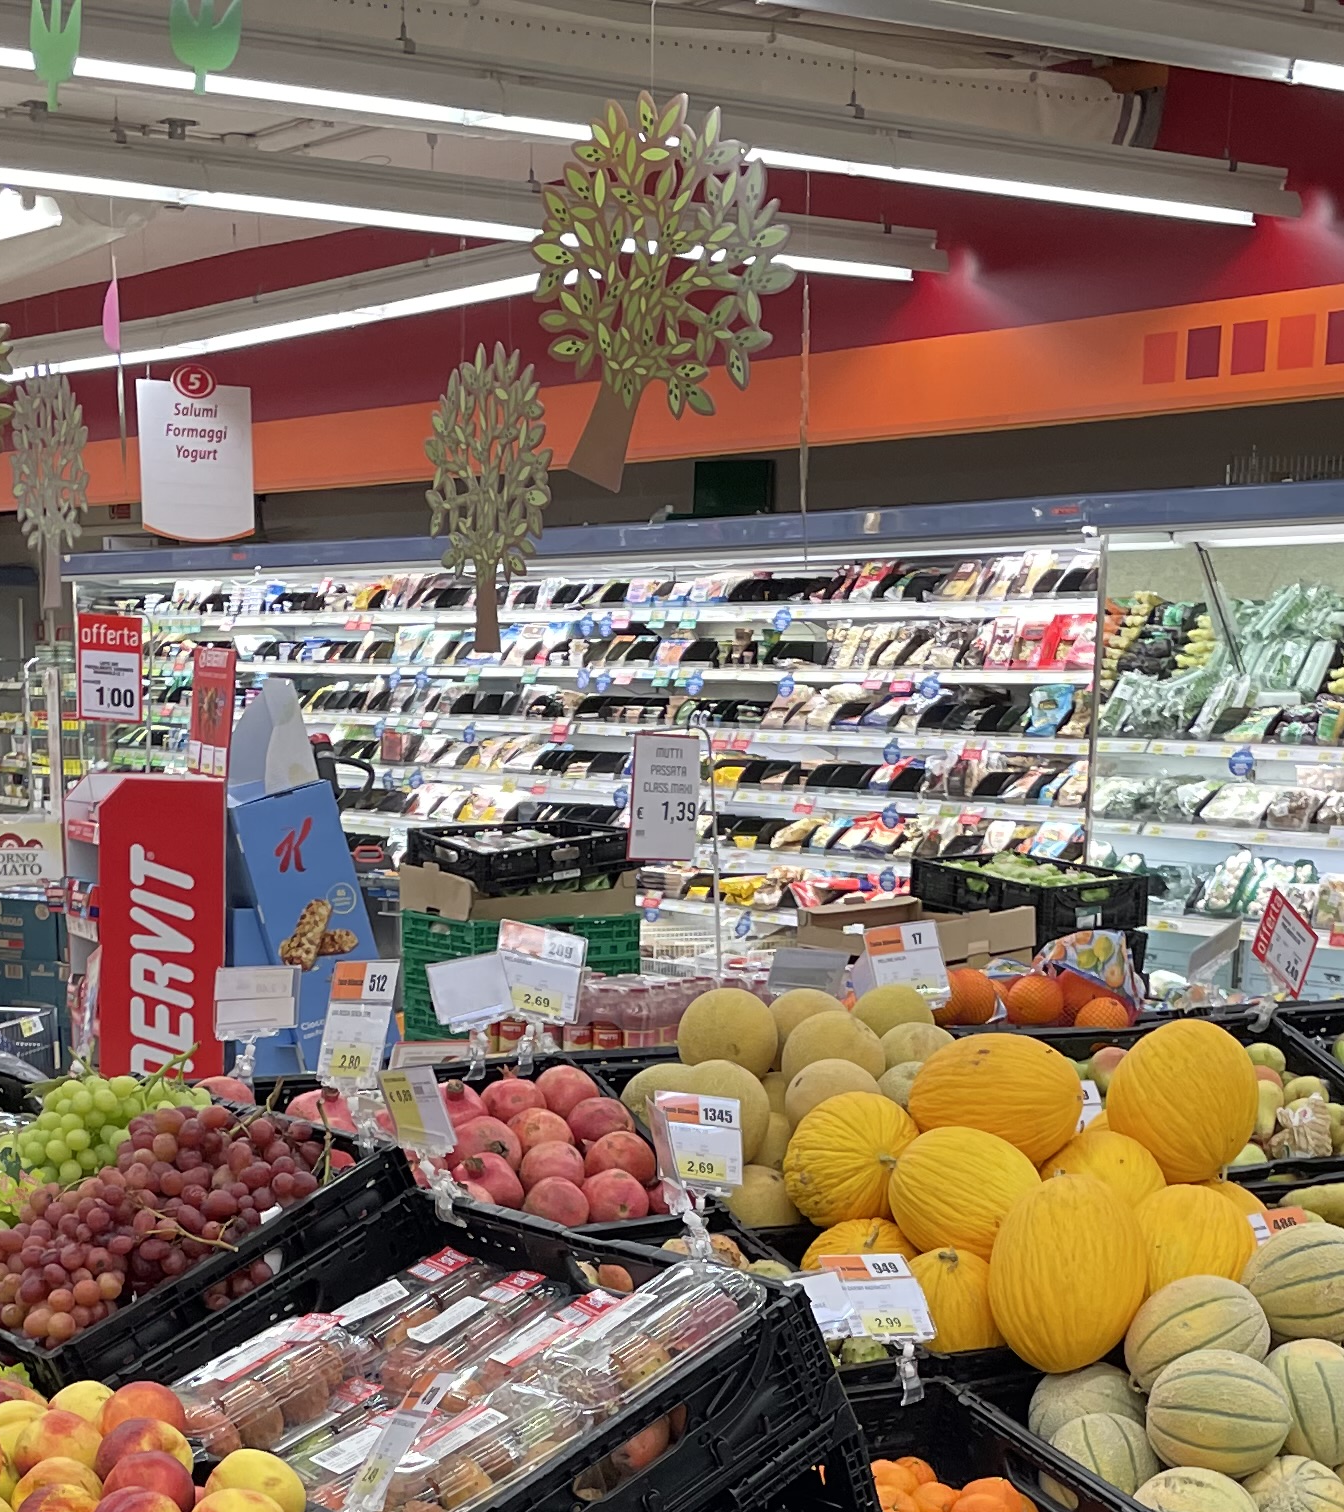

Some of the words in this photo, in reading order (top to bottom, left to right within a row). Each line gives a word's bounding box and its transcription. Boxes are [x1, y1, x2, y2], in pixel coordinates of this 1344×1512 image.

[188, 373, 202, 390] 5
[173, 402, 218, 418] Salumi
[165, 423, 228, 443] Formaggi
[175, 444, 218, 463] Yogurt
[81, 623, 140, 647] offerta
[655, 747, 684, 759] MUTTI
[650, 764, 688, 777] PASSATA
[661, 801, 696, 824] 1,39
[1257, 894, 1283, 955] offerta
[911, 932, 922, 945] 17
[129, 842, 196, 1077] ERVIT
[368, 974, 388, 993] 512
[523, 993, 550, 1008] 2,69
[340, 1054, 361, 1071] 2,80
[703, 1107, 733, 1123] 1345
[687, 1160, 714, 1175] 2,69
[871, 1261, 899, 1274] 949
[874, 1317, 902, 1329] 2,99
